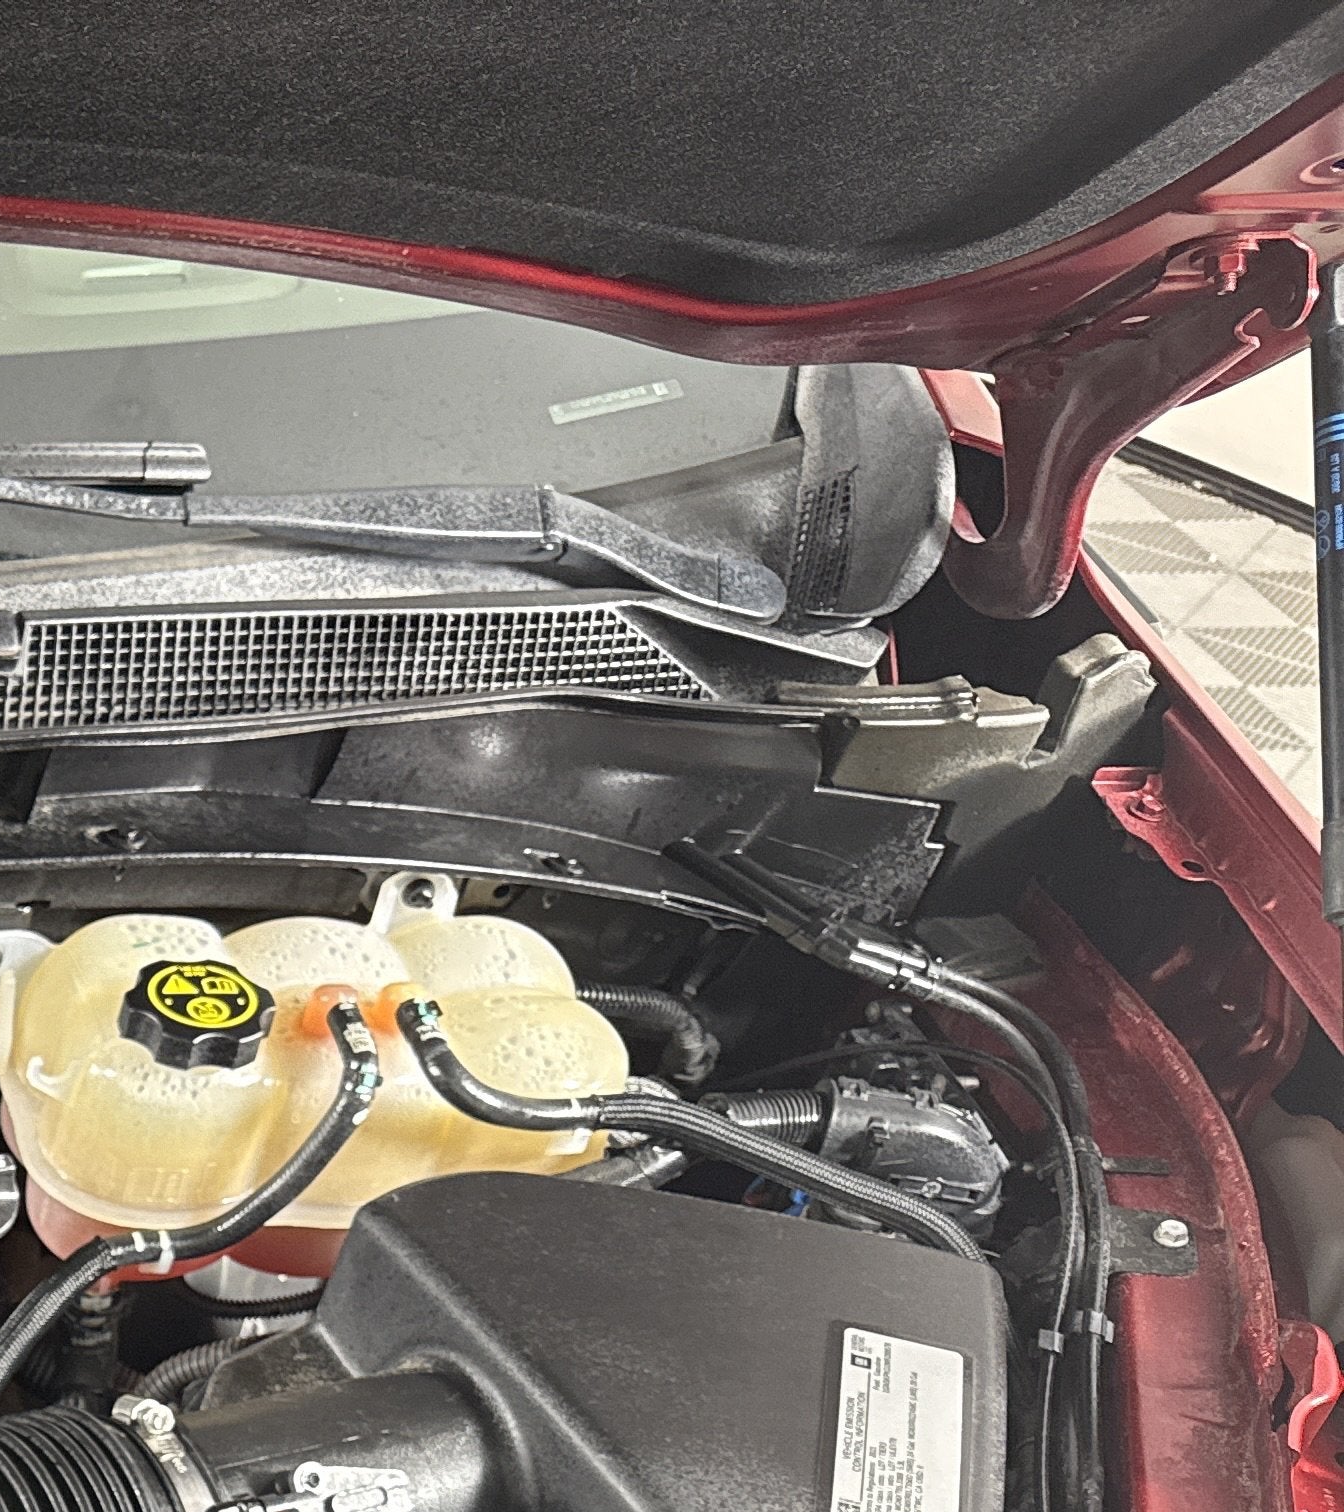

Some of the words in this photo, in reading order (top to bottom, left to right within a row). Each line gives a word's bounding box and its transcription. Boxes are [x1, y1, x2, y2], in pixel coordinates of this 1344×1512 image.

[845, 1397, 855, 1430] EMISSION
[855, 1392, 865, 1438] INFORMATION
[842, 1430, 853, 1460] VEHICLE
[852, 1439, 863, 1473] CONTROL
